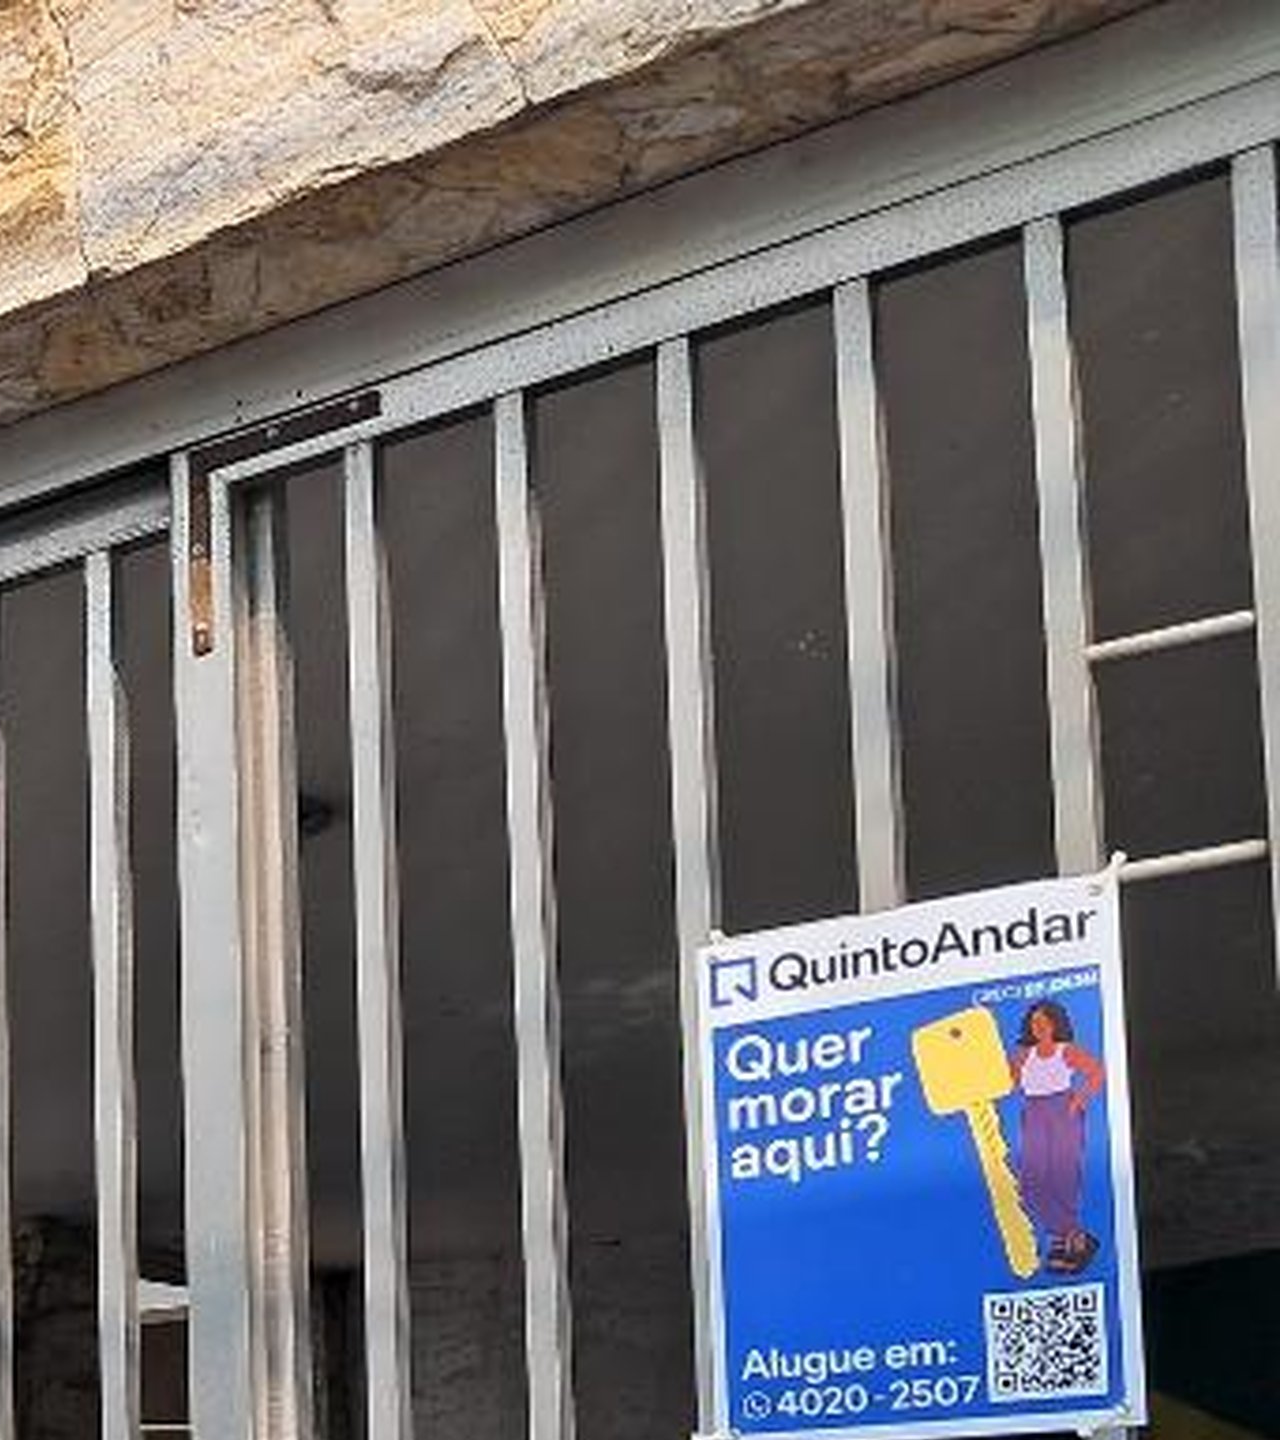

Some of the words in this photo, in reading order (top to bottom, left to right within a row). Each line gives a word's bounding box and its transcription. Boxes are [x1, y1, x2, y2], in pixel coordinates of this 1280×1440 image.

[768, 907, 1098, 992] QuintoAndar
[726, 1026, 873, 1082] Quer
[728, 1071, 903, 1131] morar
[731, 1113, 889, 1183] aqui?
[742, 1346, 876, 1384] Alugue
[884, 1339, 958, 1369] em:
